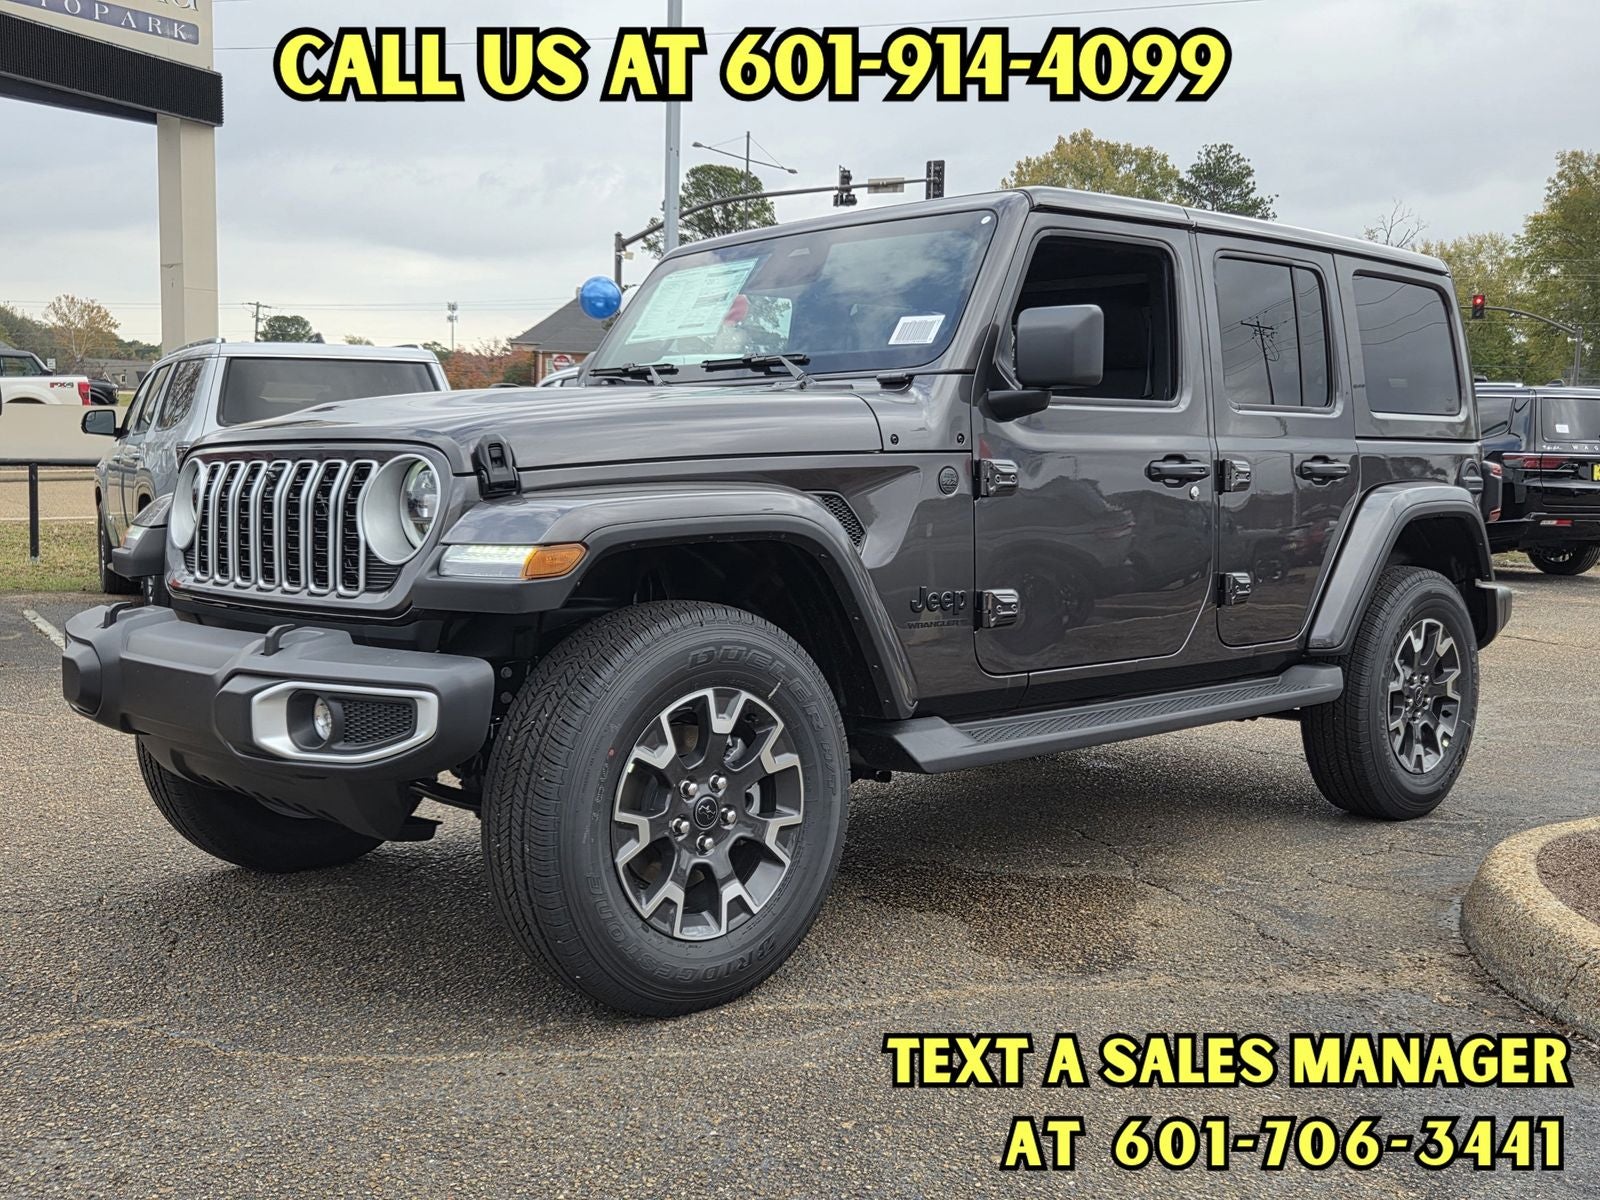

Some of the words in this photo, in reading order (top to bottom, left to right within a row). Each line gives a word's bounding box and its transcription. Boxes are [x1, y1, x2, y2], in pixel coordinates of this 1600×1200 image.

[910, 585, 967, 615] Jeep
[906, 620, 960, 630] WRANGLER
[584, 872, 776, 983] BRIDGESTONE
